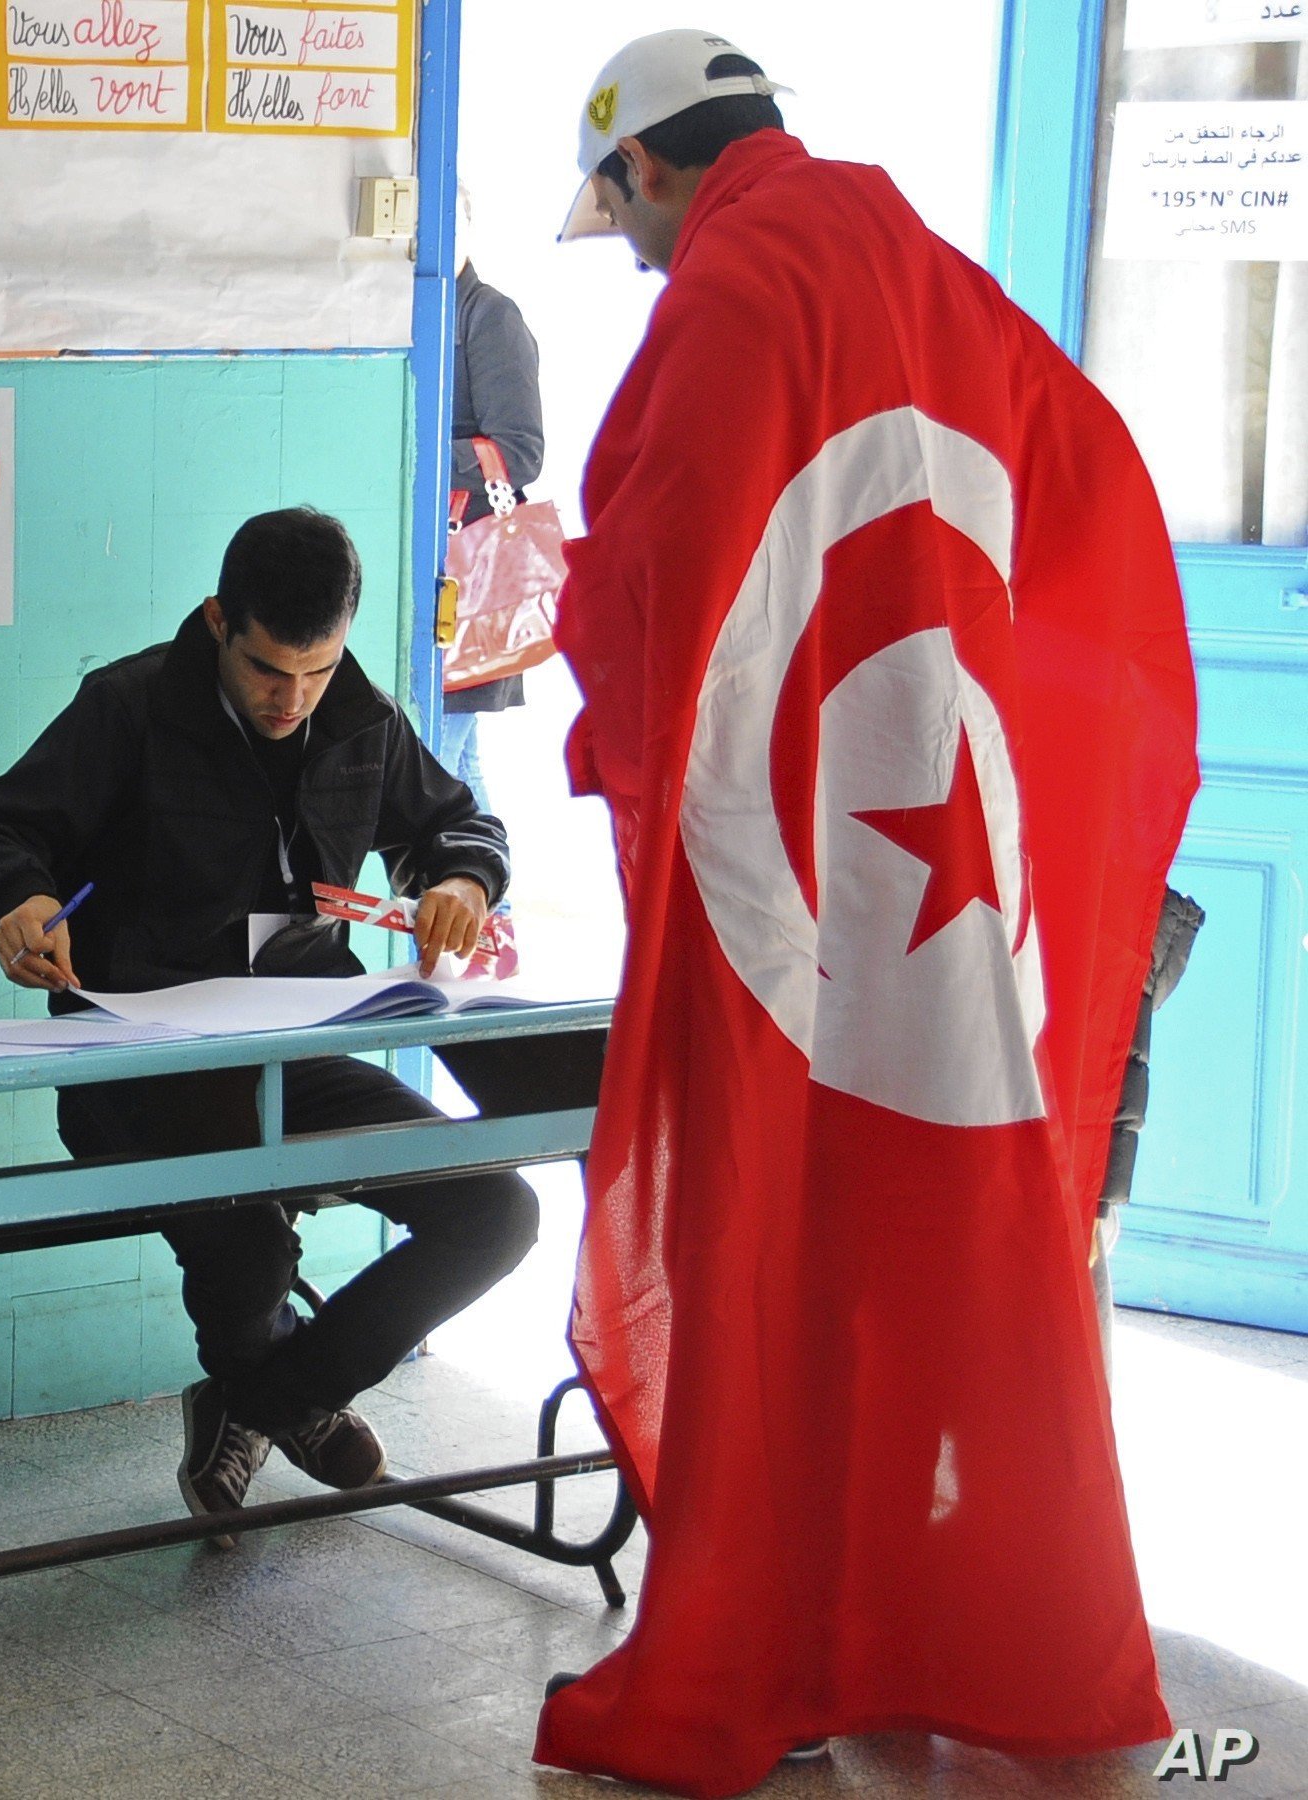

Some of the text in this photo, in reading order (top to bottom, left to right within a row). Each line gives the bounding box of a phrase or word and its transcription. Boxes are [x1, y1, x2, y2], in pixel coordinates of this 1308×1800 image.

[1260, 4, 1301, 19] عدد
[9, 0, 161, 63] Vous allez
[298, 9, 364, 66] faites
[90, 70, 175, 114] vont
[314, 72, 375, 126] font
[1165, 130, 1184, 143] من
[1240, 125, 1284, 142] الرجاء
[1193, 150, 1233, 165] الصف
[1238, 149, 1257, 168] في
[1261, 151, 1302, 165] عددكم
[1241, 190, 1289, 207] CIN#
[1220, 220, 1257, 235] SMS
